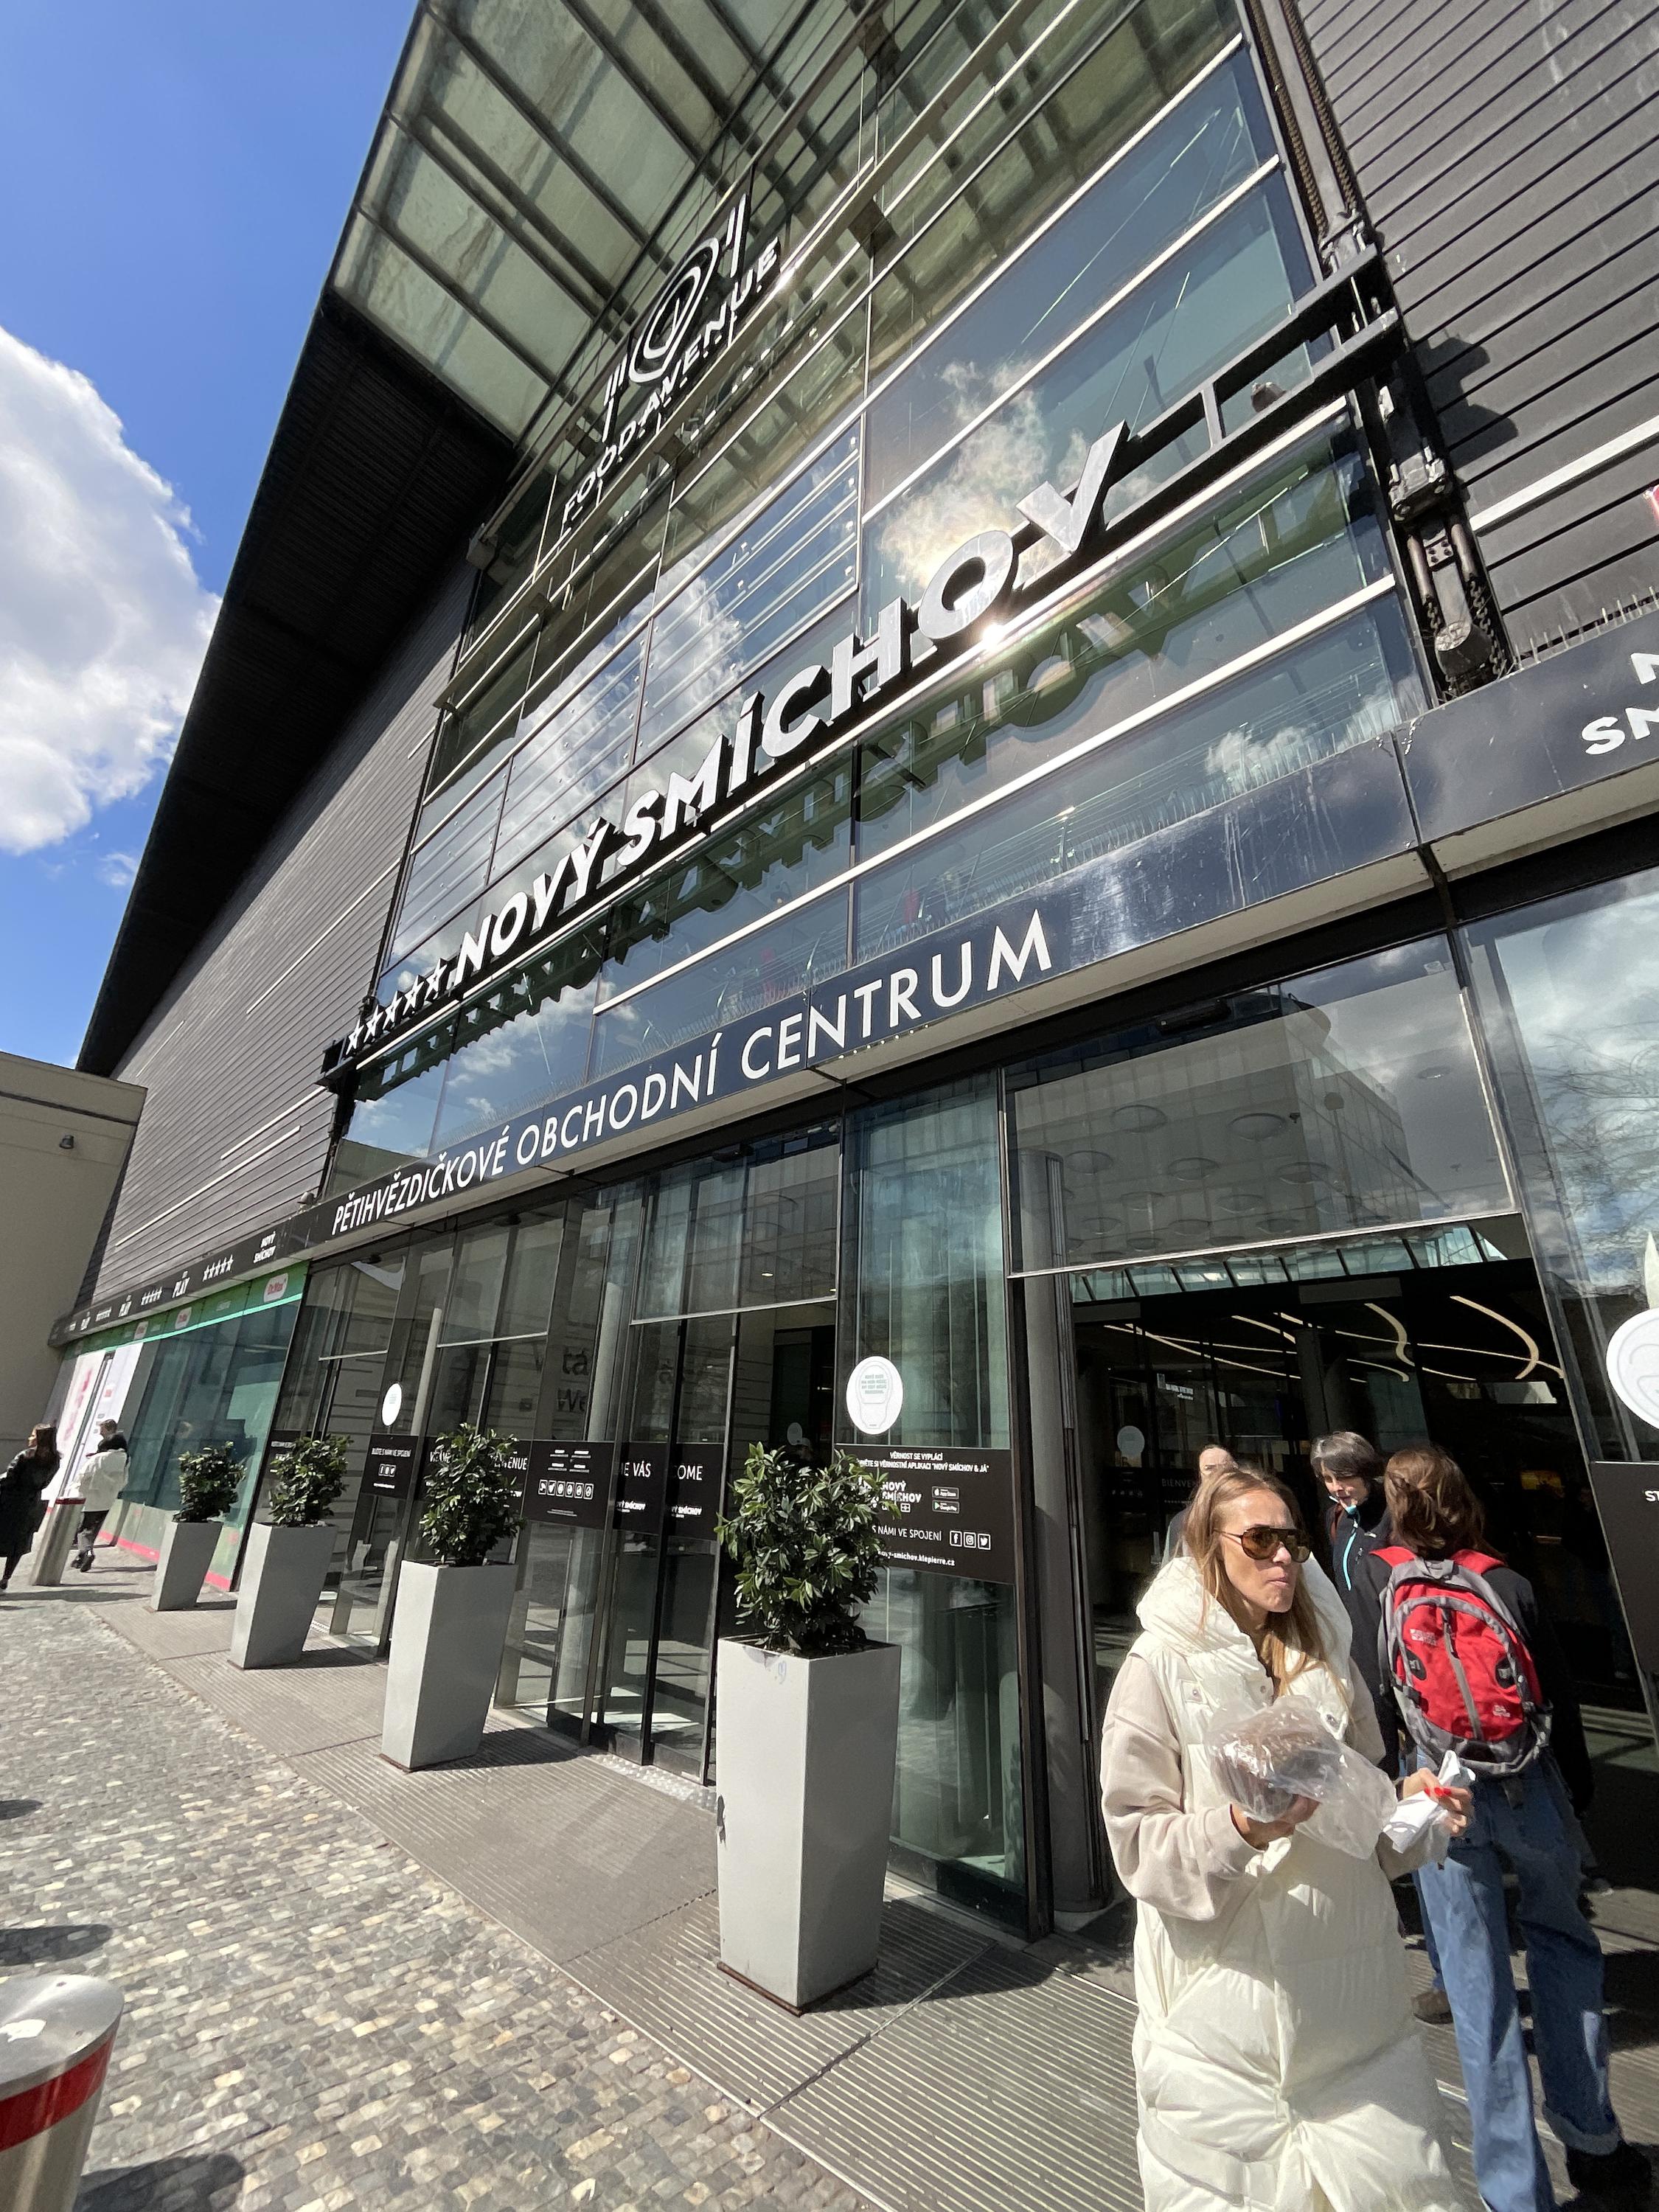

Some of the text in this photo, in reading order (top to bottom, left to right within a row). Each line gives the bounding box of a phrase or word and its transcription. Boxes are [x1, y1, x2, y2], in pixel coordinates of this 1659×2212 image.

[562, 236, 779, 526] FOOD AVENUE
[453, 419, 1128, 986] NOVÝ SMÍCHOV
[331, 909, 1053, 1236] PĚTIHVĚZDIČKOVÉ OBCHODNÍ CENTRUM
[877, 1525, 897, 1537] NÁMI
[898, 1528, 908, 1537] VE
[909, 1529, 942, 1542] SPOJENÍ
